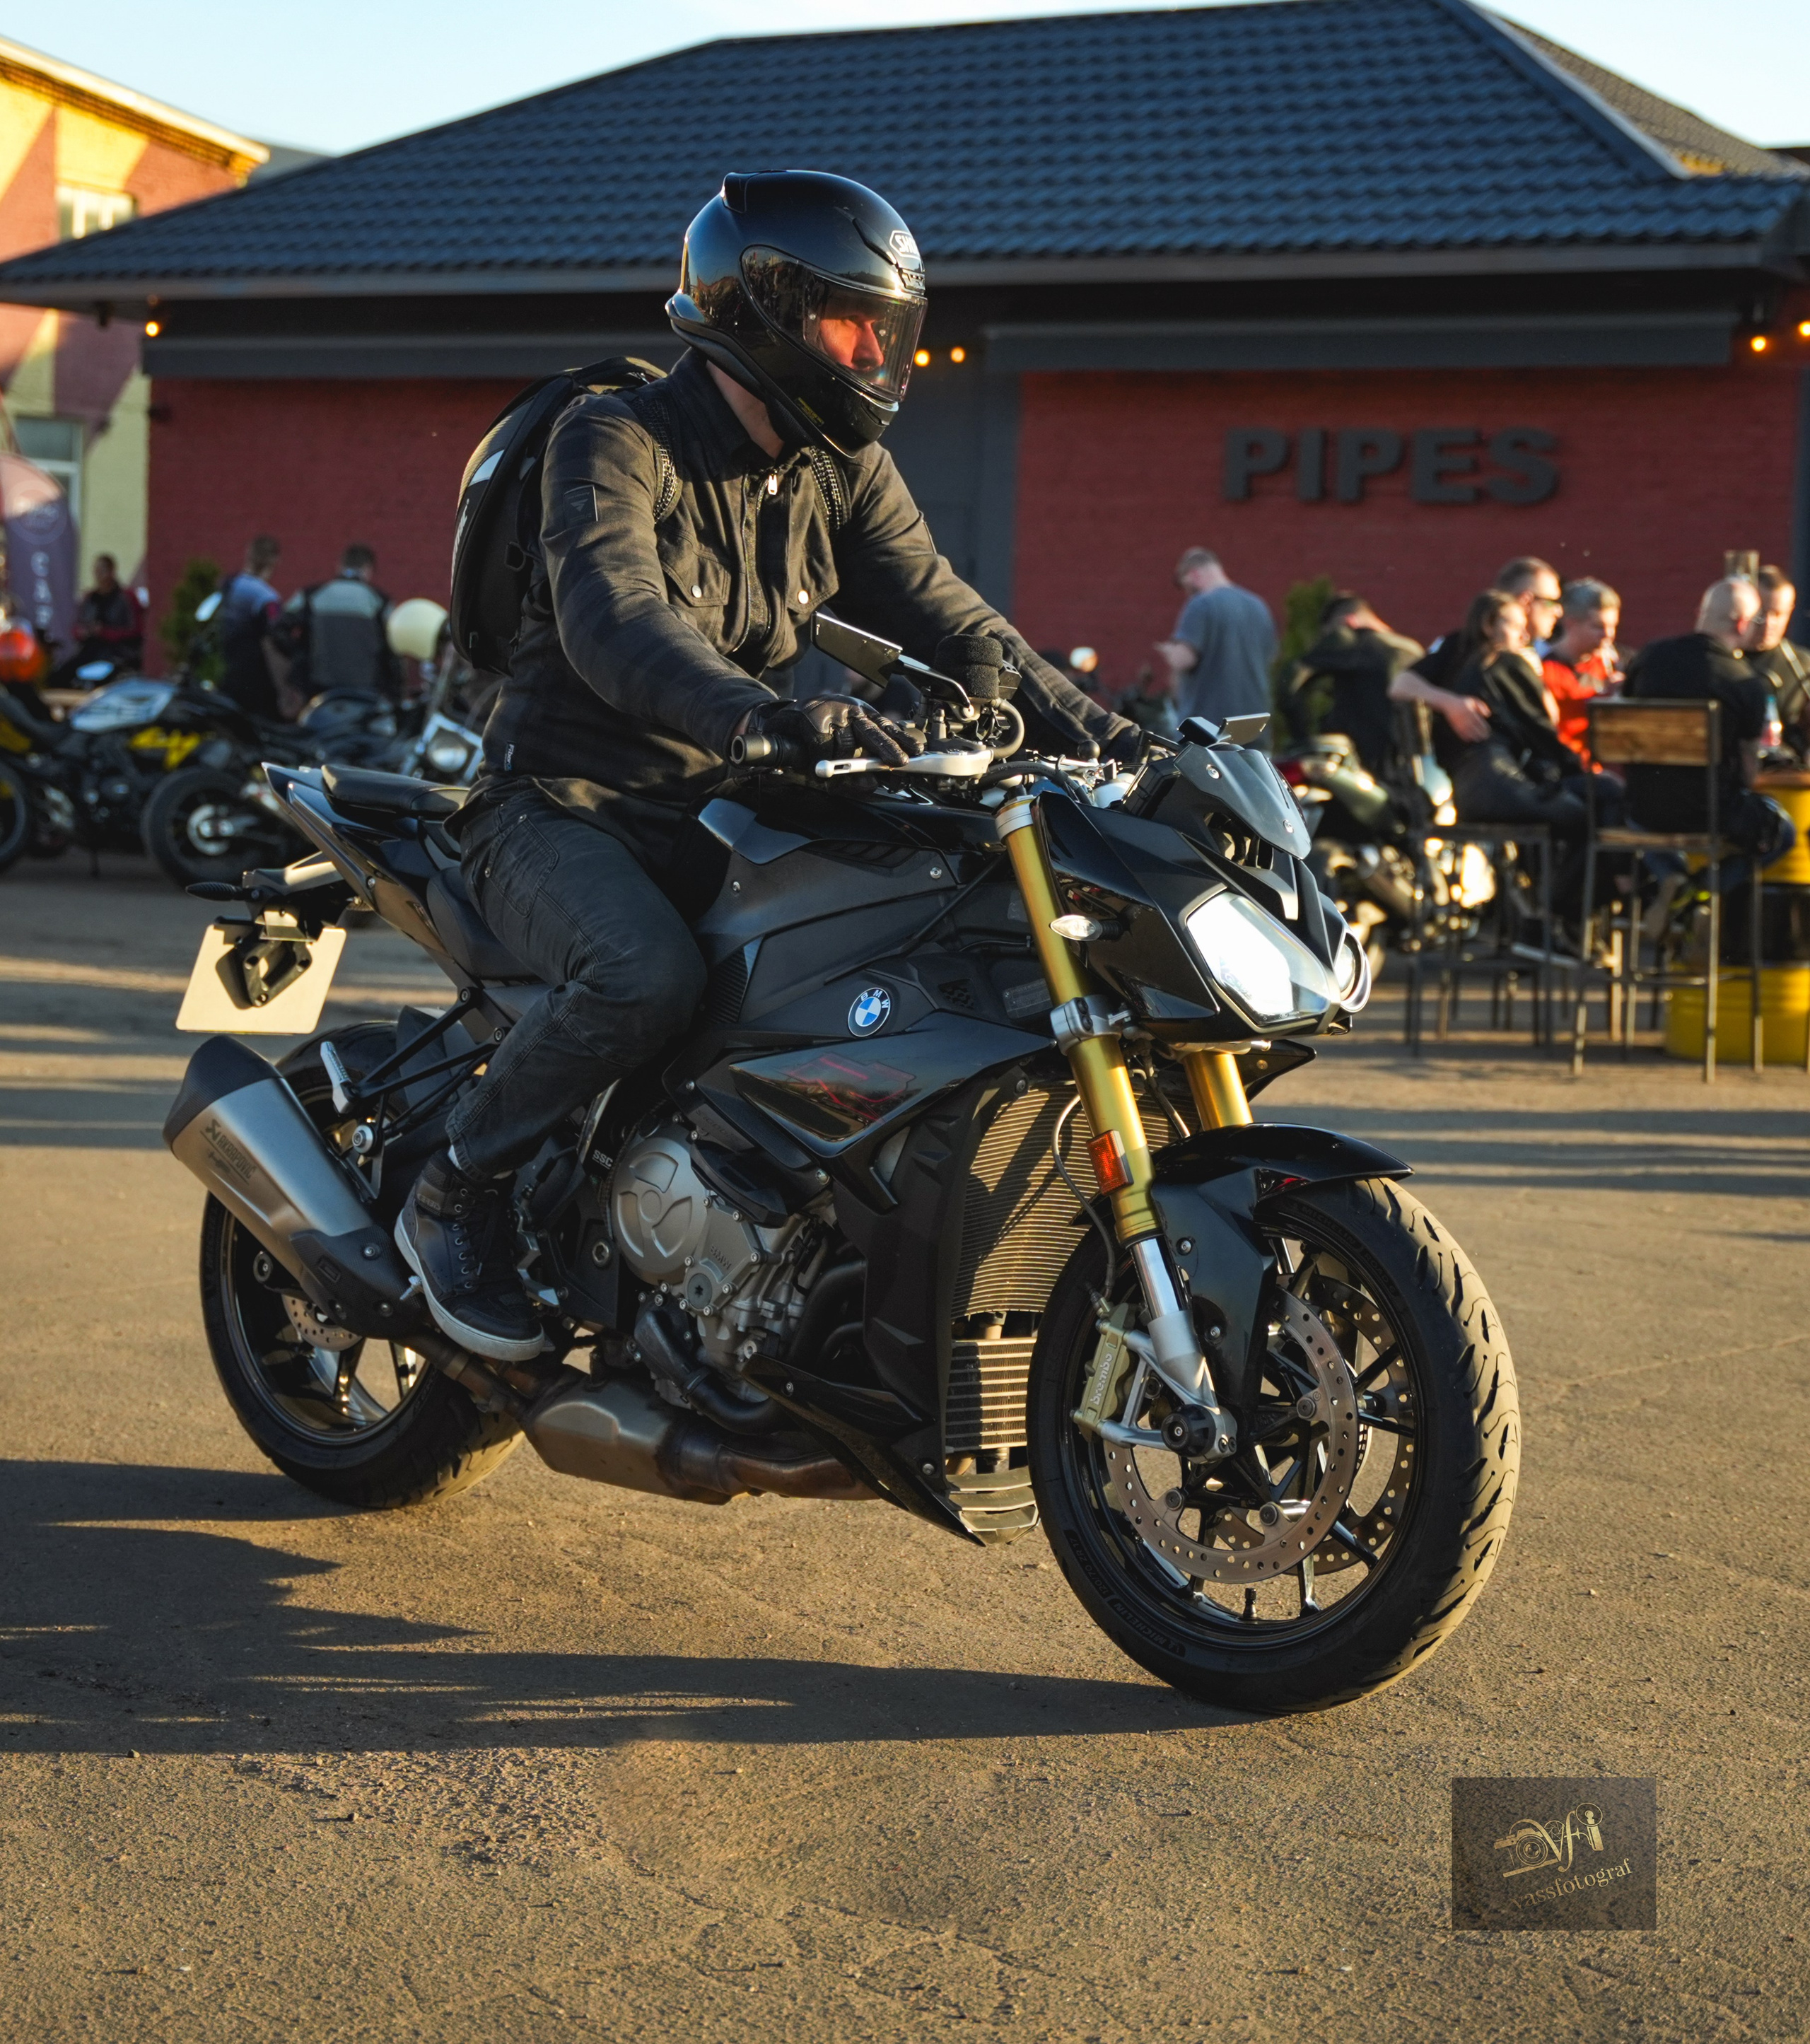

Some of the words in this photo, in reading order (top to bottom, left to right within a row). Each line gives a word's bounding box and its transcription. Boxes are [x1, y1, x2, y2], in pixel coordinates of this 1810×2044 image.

[1223, 426, 1558, 506] PIPES
[860, 989, 890, 1009] BMW
[592, 1149, 614, 1167] SSC
[709, 1244, 732, 1271] BMW
[1363, 1252, 1389, 1284] ROAD
[1090, 1353, 1113, 1406] brembo
[1084, 1564, 1107, 1596] 120/70
[1113, 1602, 1167, 1646] MICHELIN
